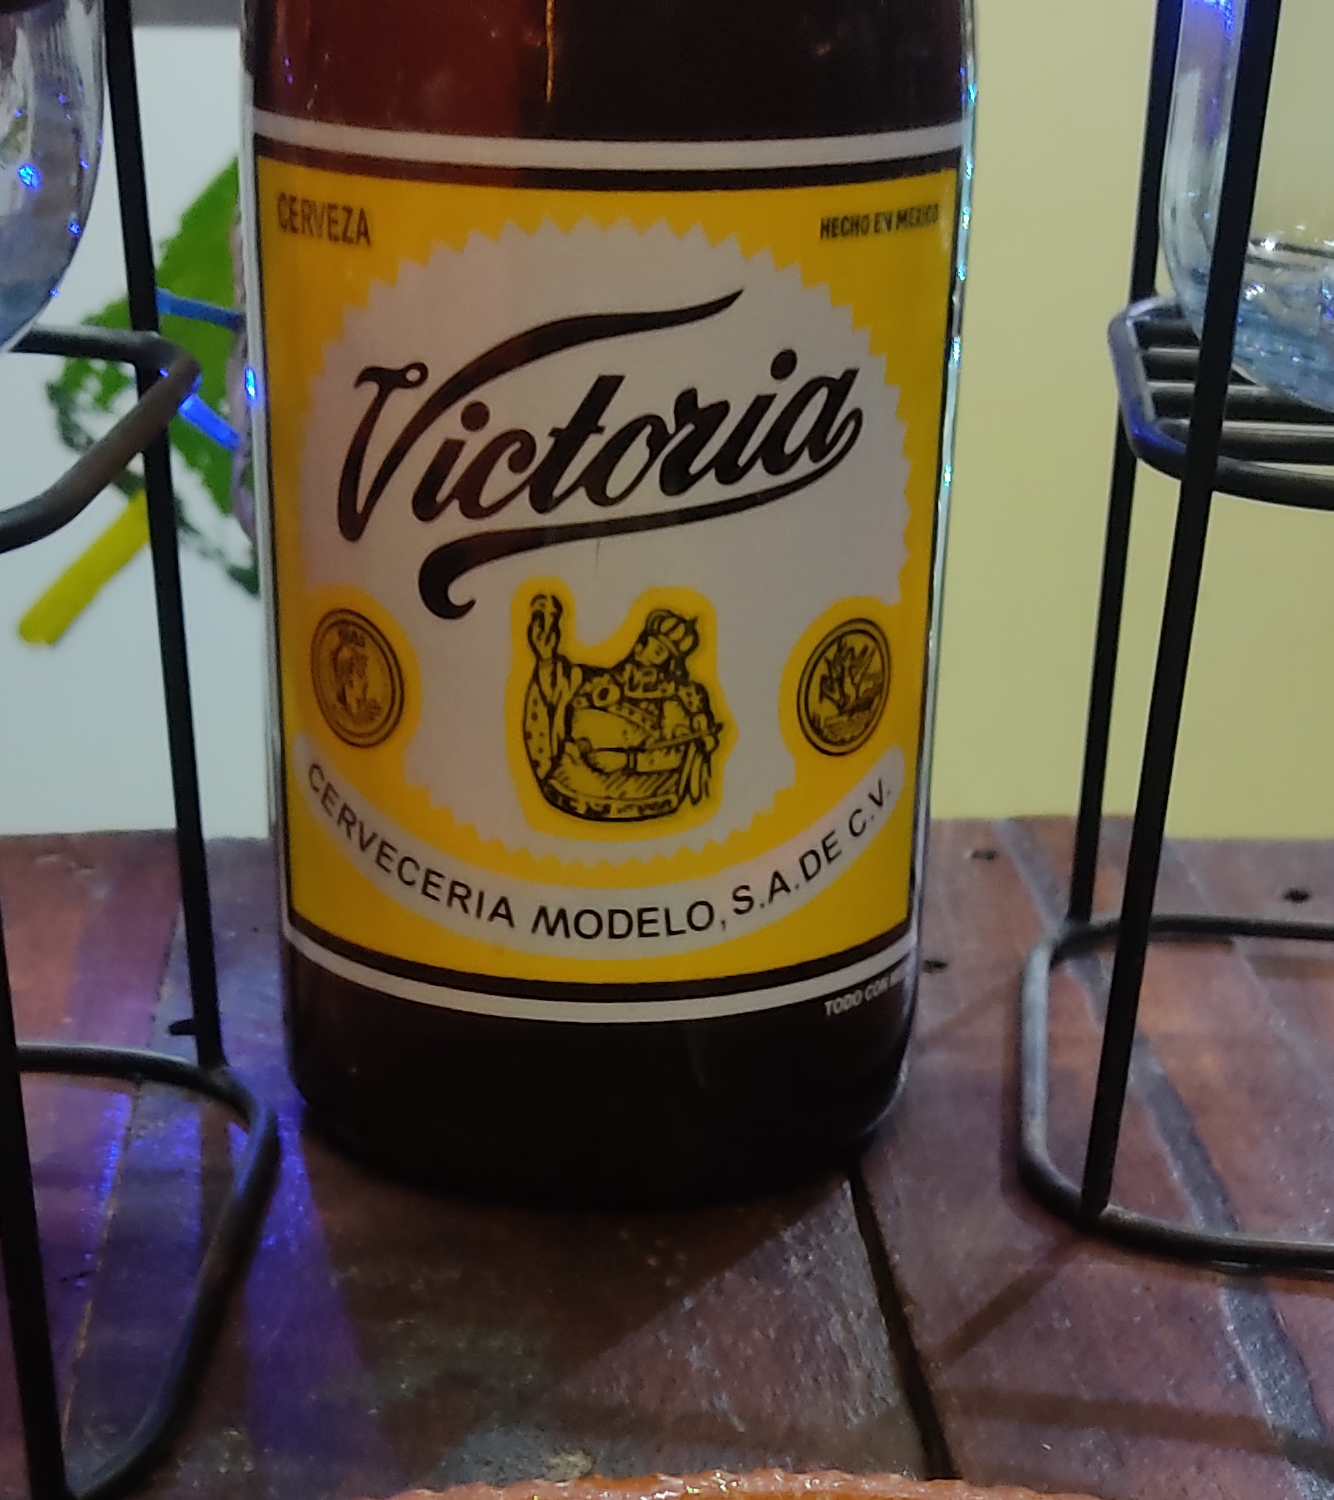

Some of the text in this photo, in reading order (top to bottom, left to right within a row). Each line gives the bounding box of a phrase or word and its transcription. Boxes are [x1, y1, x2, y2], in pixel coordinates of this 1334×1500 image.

[278, 192, 371, 246] CERVEZA
[820, 213, 869, 240] HECHO
[874, 211, 892, 234] EN
[337, 288, 865, 621] Victoria
[308, 763, 515, 928] CERVECERIA
[531, 900, 727, 940] MODELO,
[848, 777, 892, 838] C.V.
[824, 989, 863, 1016] TODO
